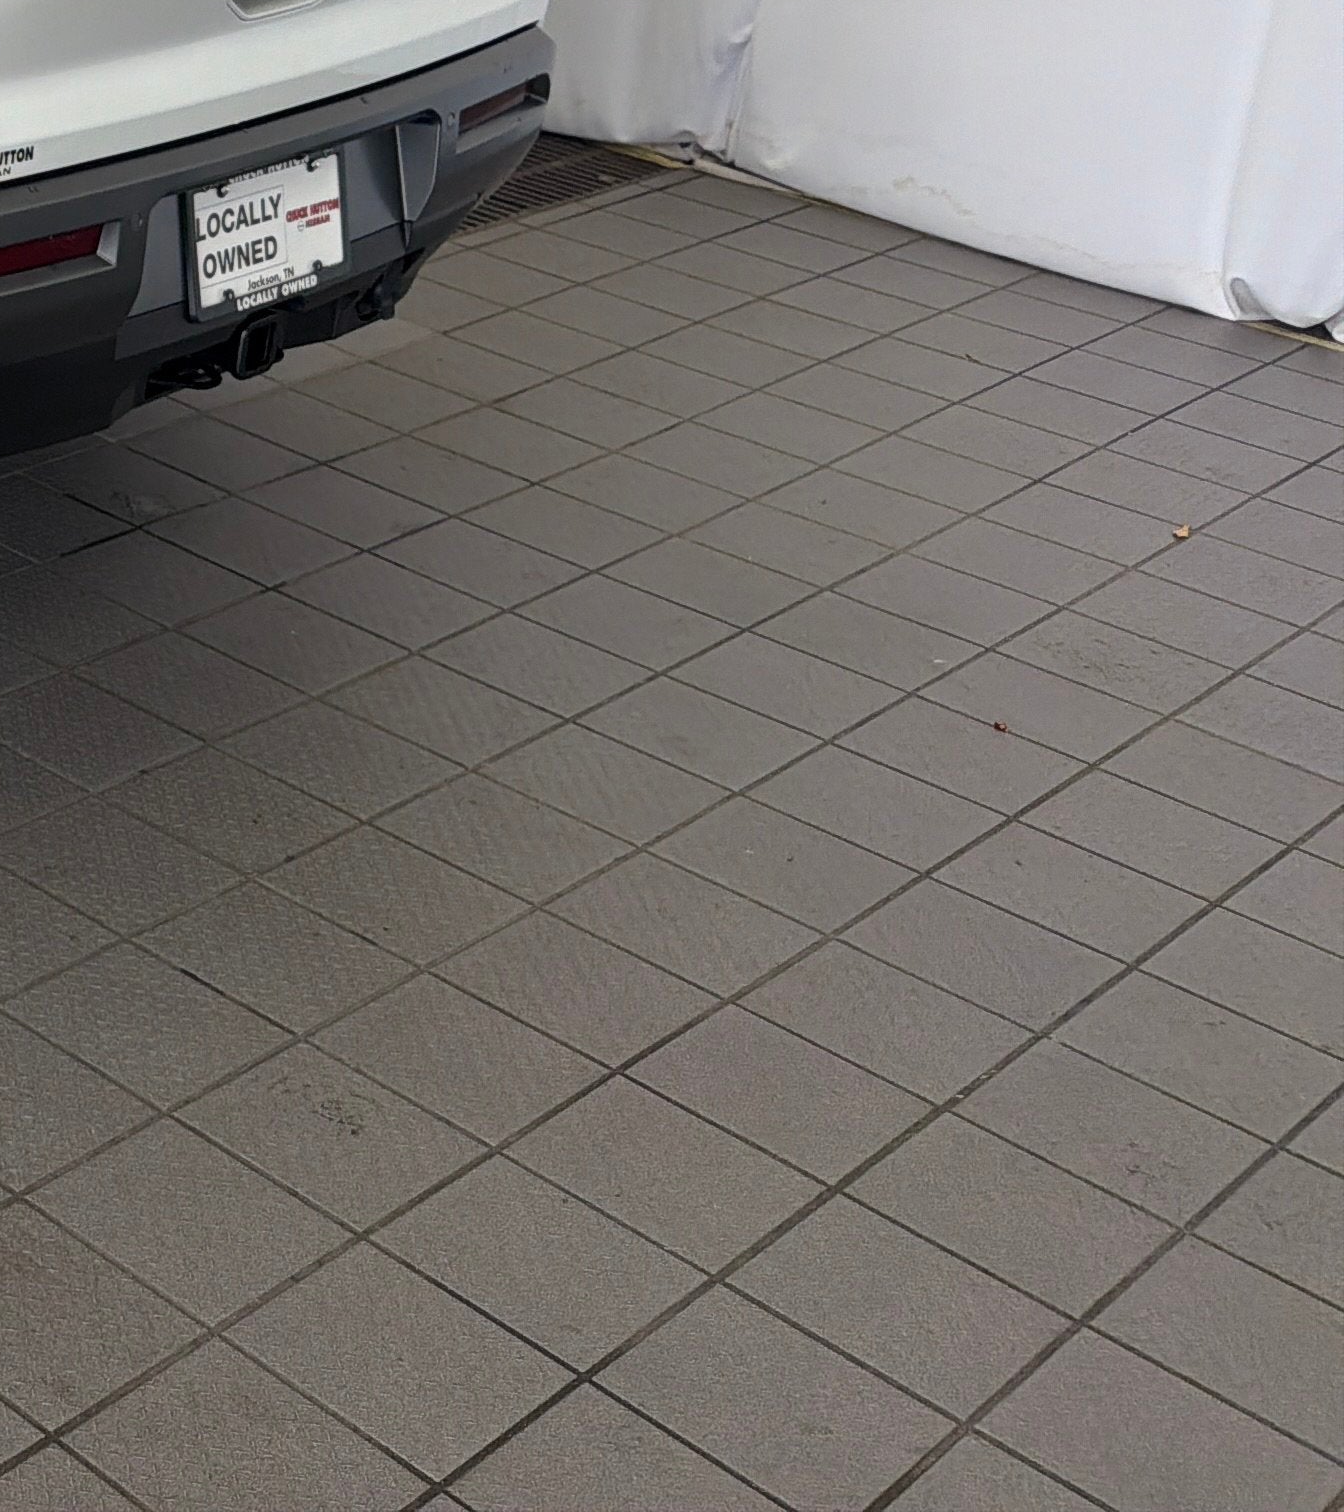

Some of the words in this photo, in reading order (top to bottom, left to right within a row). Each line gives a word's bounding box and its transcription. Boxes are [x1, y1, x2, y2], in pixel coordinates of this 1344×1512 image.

[195, 192, 282, 242] LOCALLY
[202, 235, 278, 279] OWNED
[236, 286, 279, 312] LOCALLY
[281, 274, 318, 297] OWNED
[247, 273, 282, 291] Jackson,
[282, 265, 295, 279] TN
